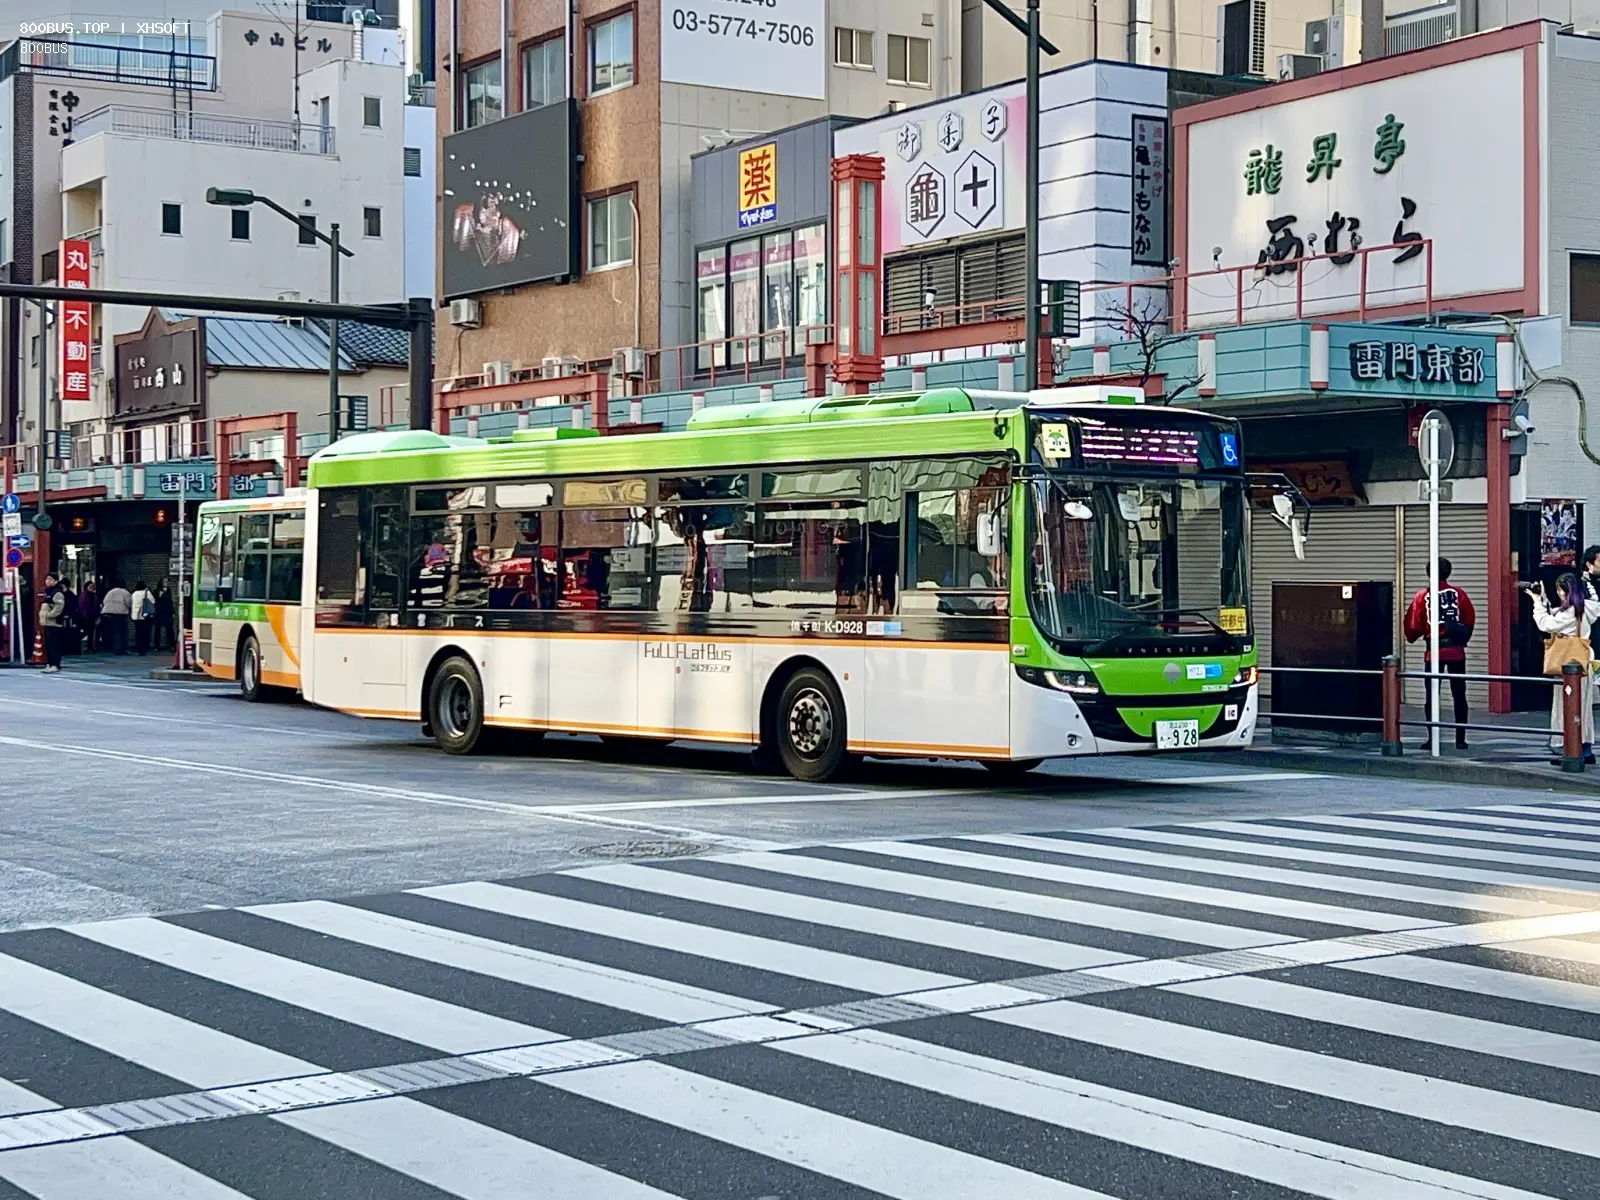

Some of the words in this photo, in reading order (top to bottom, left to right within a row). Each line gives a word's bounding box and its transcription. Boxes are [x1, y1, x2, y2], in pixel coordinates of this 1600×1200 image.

[244, 28, 333, 54] 中山ビル
[672, 8, 814, 47] 03-5774-7506
[61, 90, 80, 148] 中山
[1243, 113, 1406, 195] 龍昇亭
[744, 149, 771, 208] 薬
[1351, 341, 1485, 384] 雷門東部
[160, 472, 254, 492] 雷門部
[824, 621, 863, 634] K-D928
[707, 644, 731, 660] Bus
